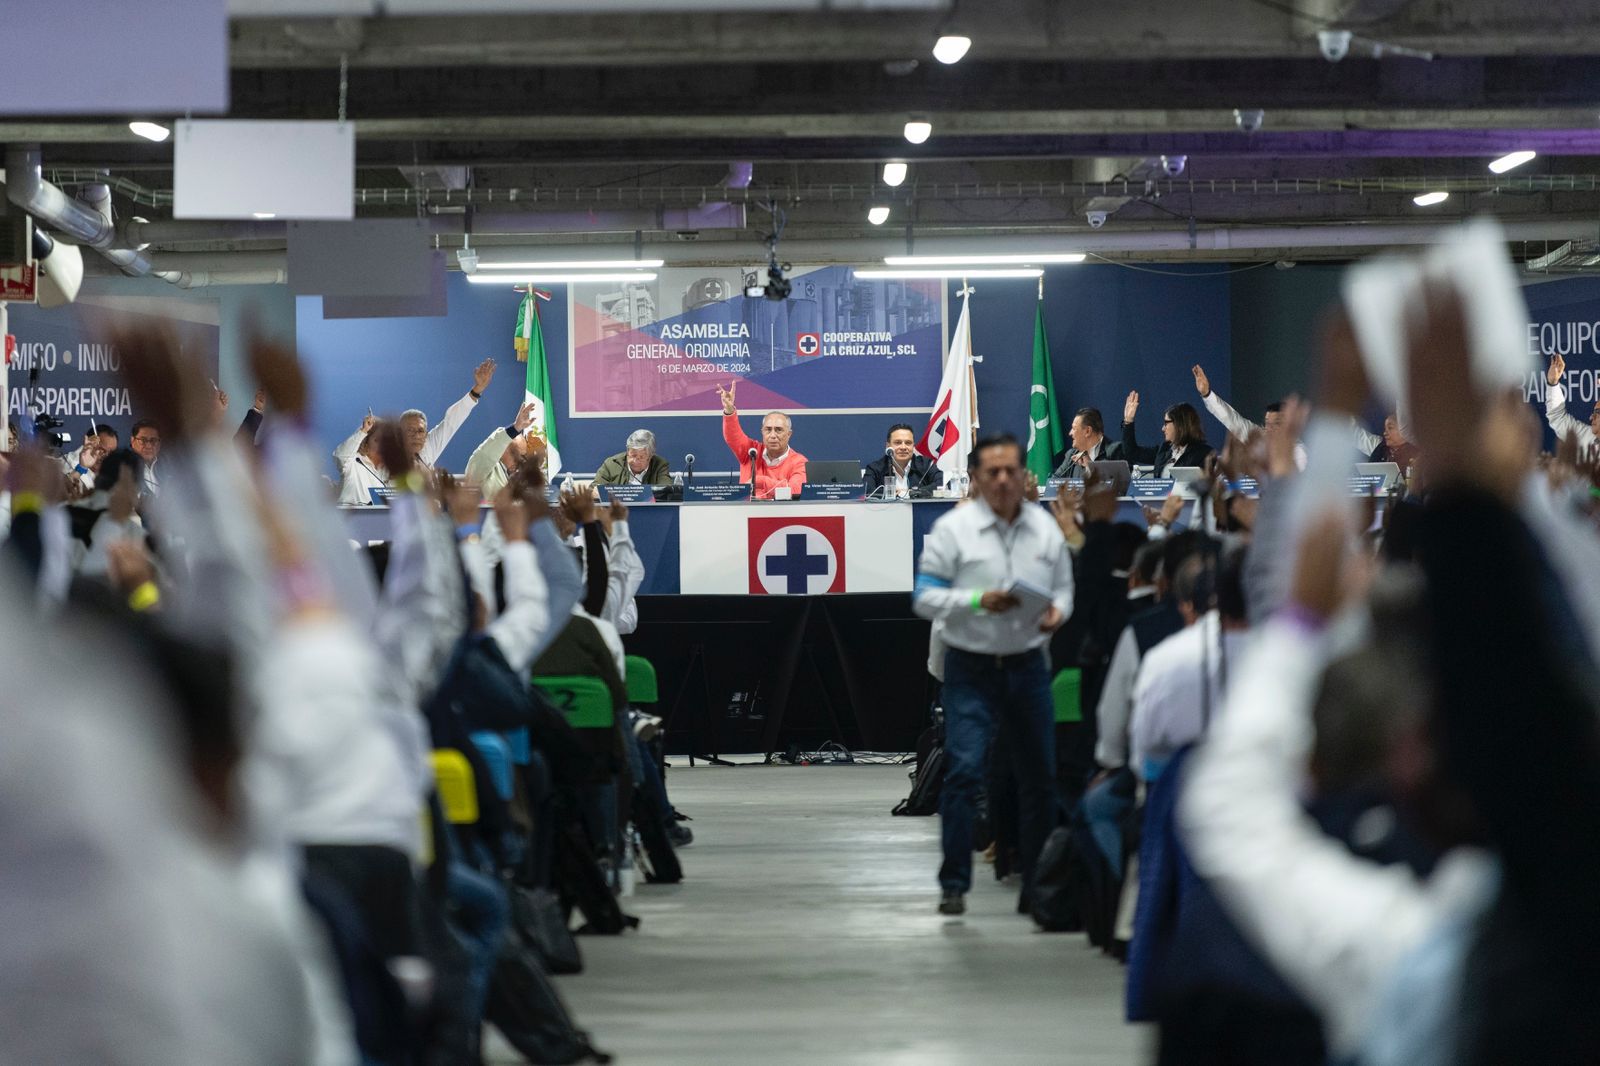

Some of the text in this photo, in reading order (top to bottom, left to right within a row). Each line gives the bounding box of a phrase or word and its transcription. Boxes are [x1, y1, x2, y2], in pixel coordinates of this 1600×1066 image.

[660, 322, 750, 339] ASAMBLEA
[823, 331, 893, 343] COOPERATIVA
[626, 342, 751, 359] GENERAL ORDINARIA
[823, 344, 917, 357] LA CRUZ AZUL, SCL
[657, 363, 751, 373] 16 DE MARZO DE 2024
[555, 688, 577, 711] 2
